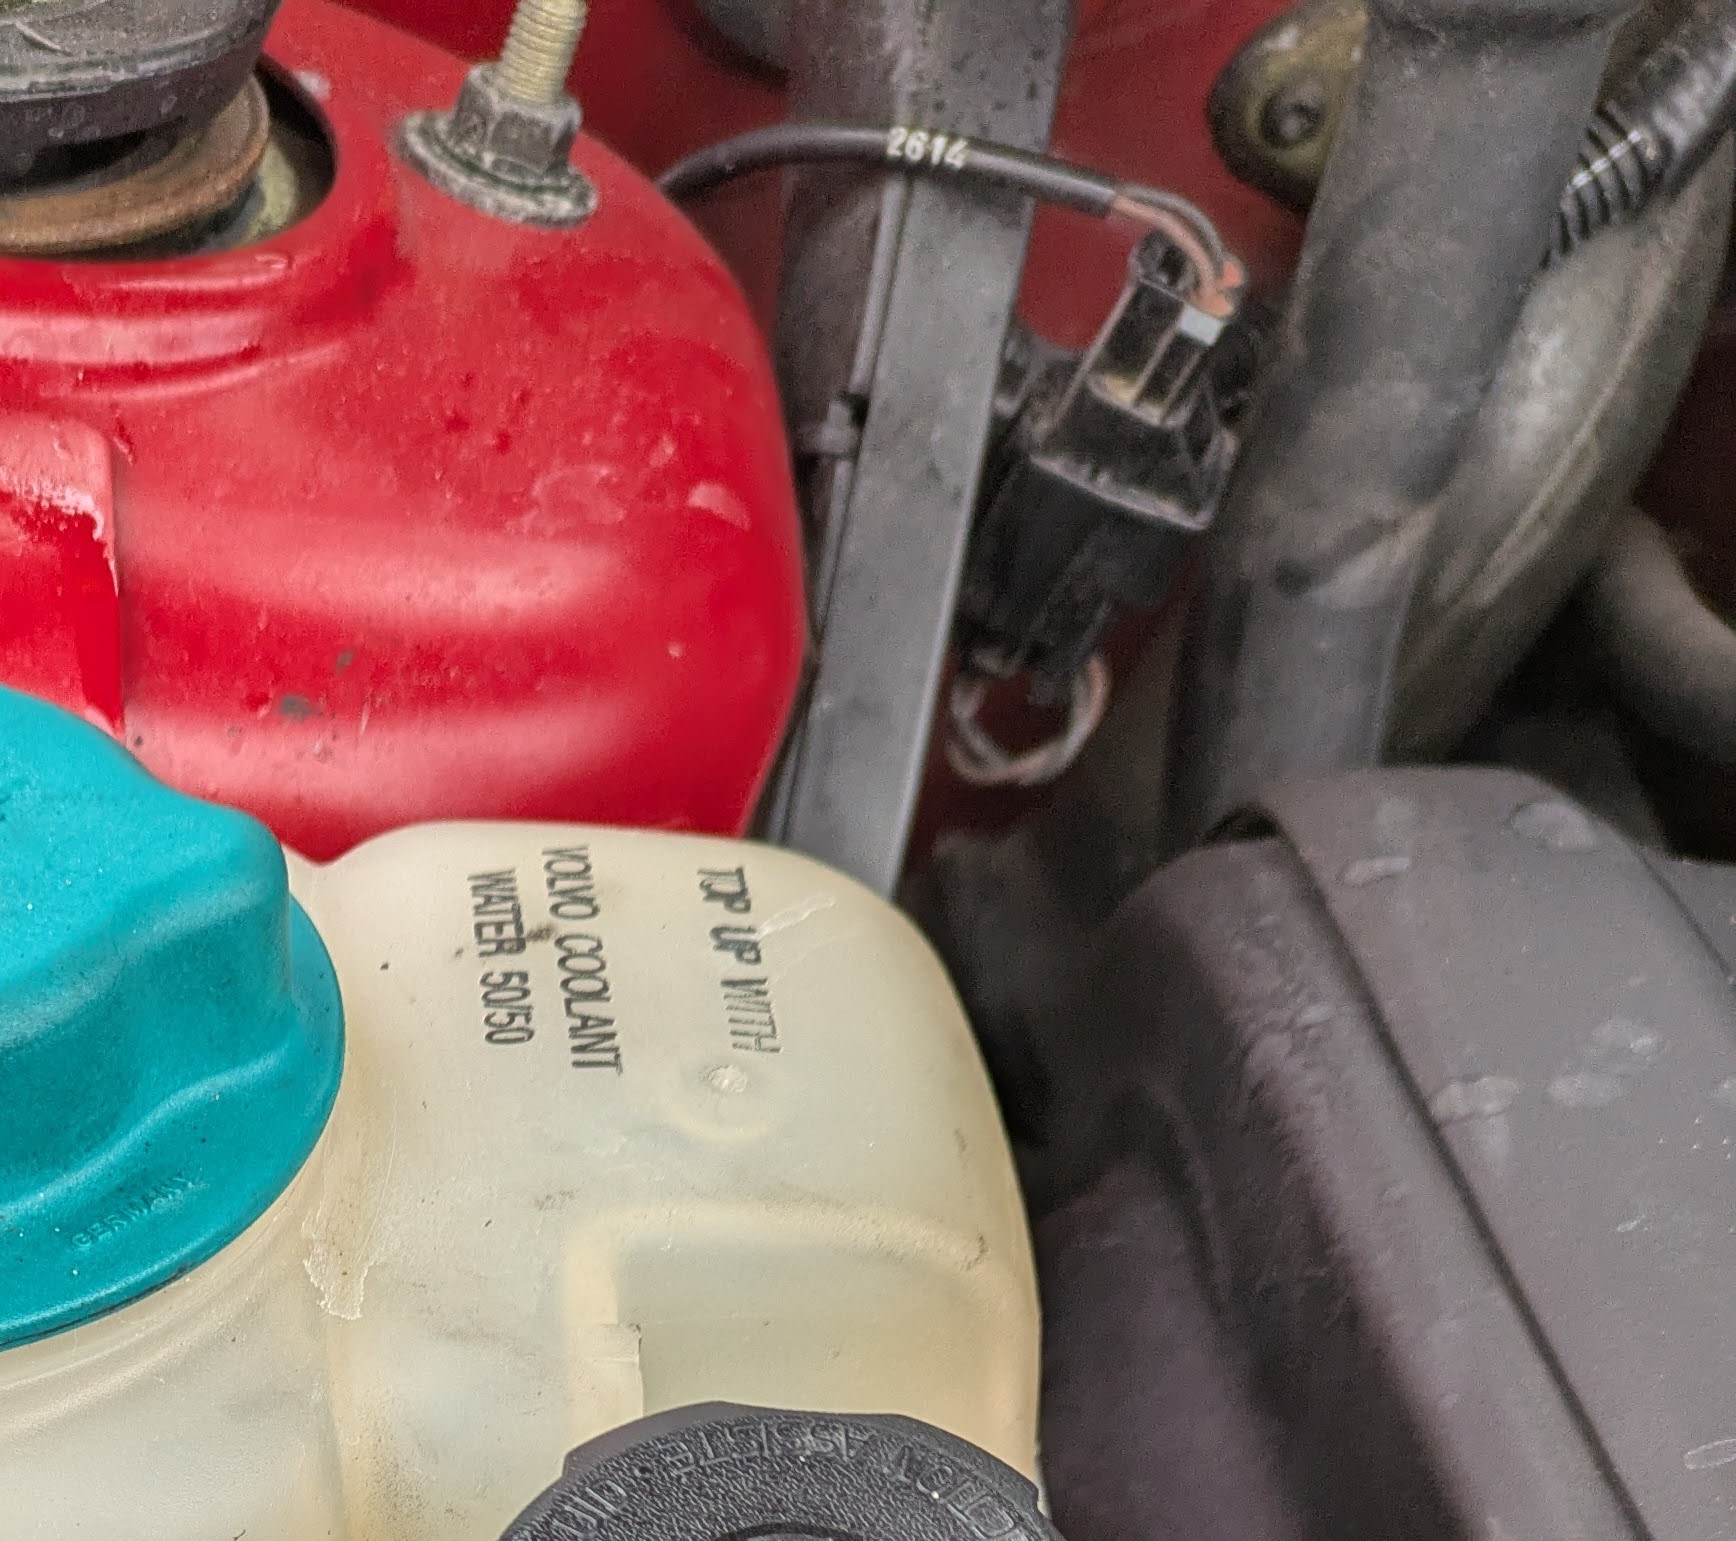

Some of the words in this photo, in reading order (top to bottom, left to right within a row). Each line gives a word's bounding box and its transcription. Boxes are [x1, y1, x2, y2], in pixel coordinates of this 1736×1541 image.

[886, 126, 968, 170] 2614
[467, 868, 527, 959] WATER
[541, 844, 599, 921] VOLVO
[697, 866, 752, 914] TOP
[710, 924, 762, 966] UP
[479, 970, 535, 1046] 50/50
[554, 934, 623, 1074] COOLANT
[721, 977, 782, 1054] WITH
